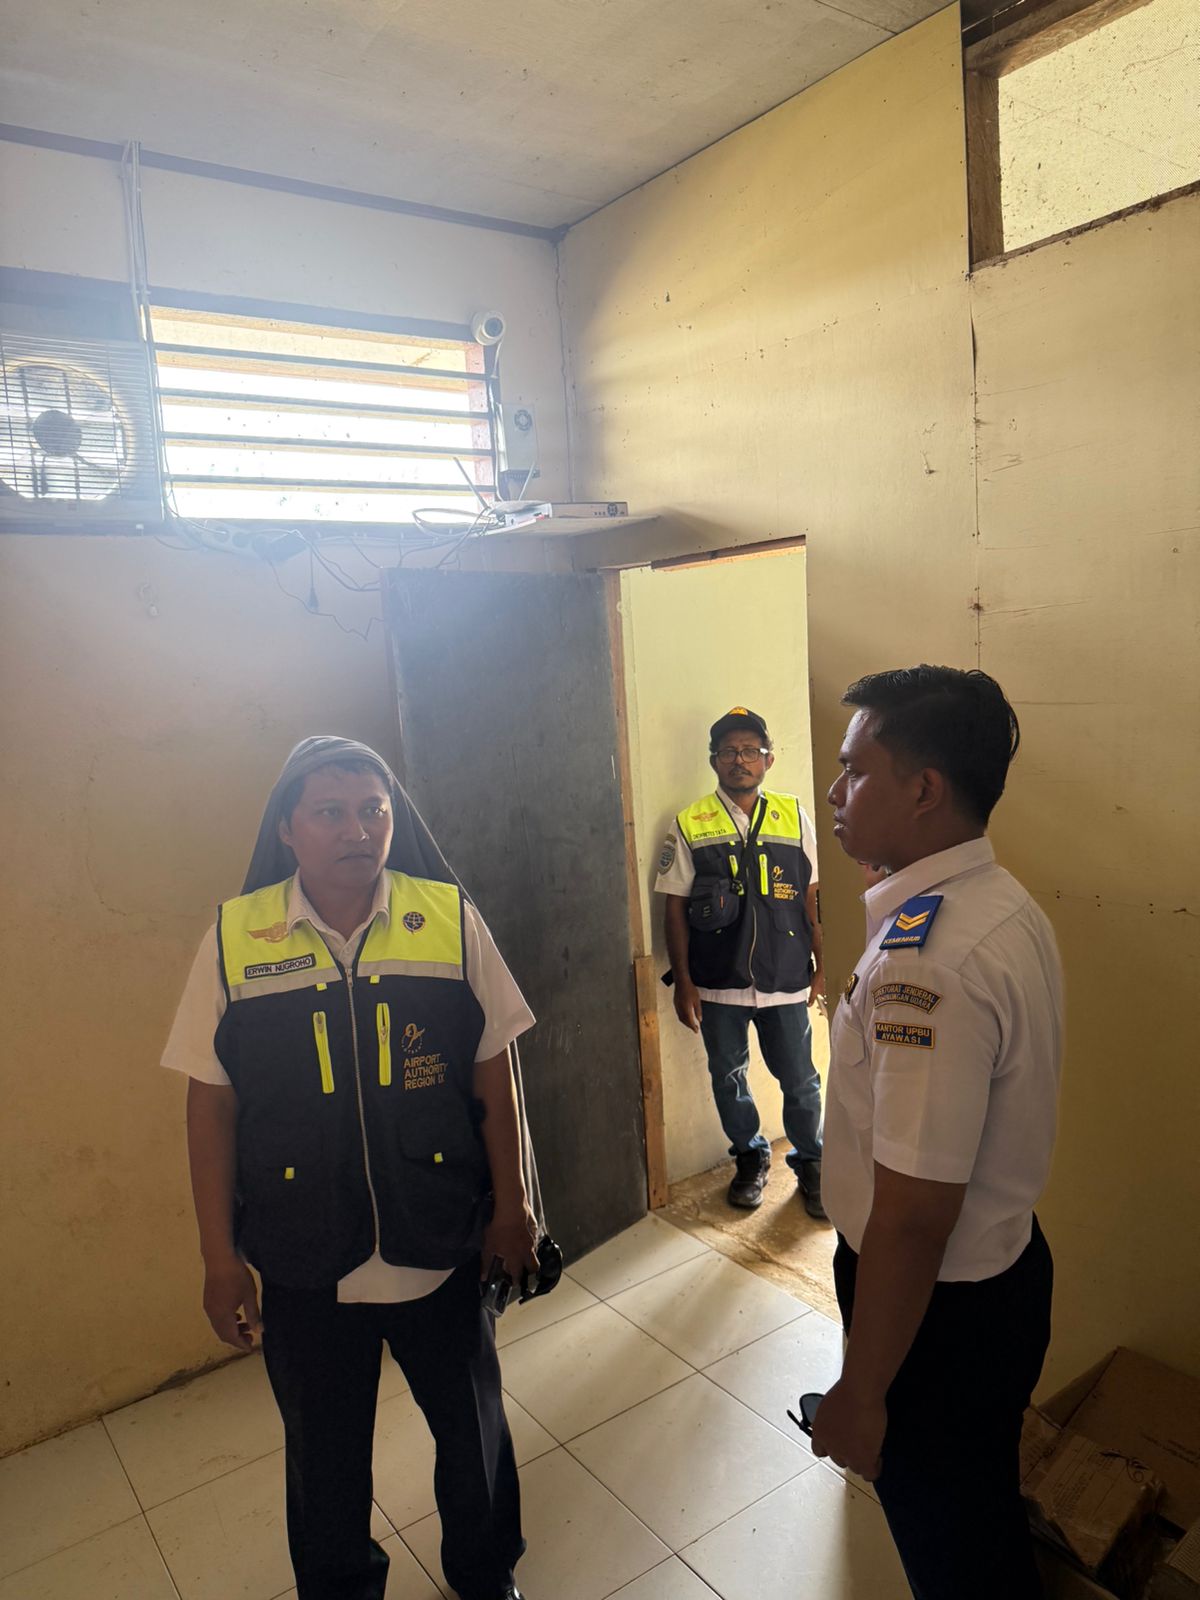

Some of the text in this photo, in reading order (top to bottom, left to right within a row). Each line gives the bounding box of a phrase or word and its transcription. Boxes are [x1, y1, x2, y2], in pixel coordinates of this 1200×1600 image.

[247, 957, 311, 976] ERWIN NUGROHO
[902, 986, 936, 1003] JENDERAL
[876, 1023, 930, 1037] KANTOR UPBU
[881, 1032, 921, 1044] AYAWASI
[403, 1053, 441, 1069] AIRPORT
[404, 1062, 449, 1080] AUTHORITY
[404, 1073, 445, 1091] REGION IX
